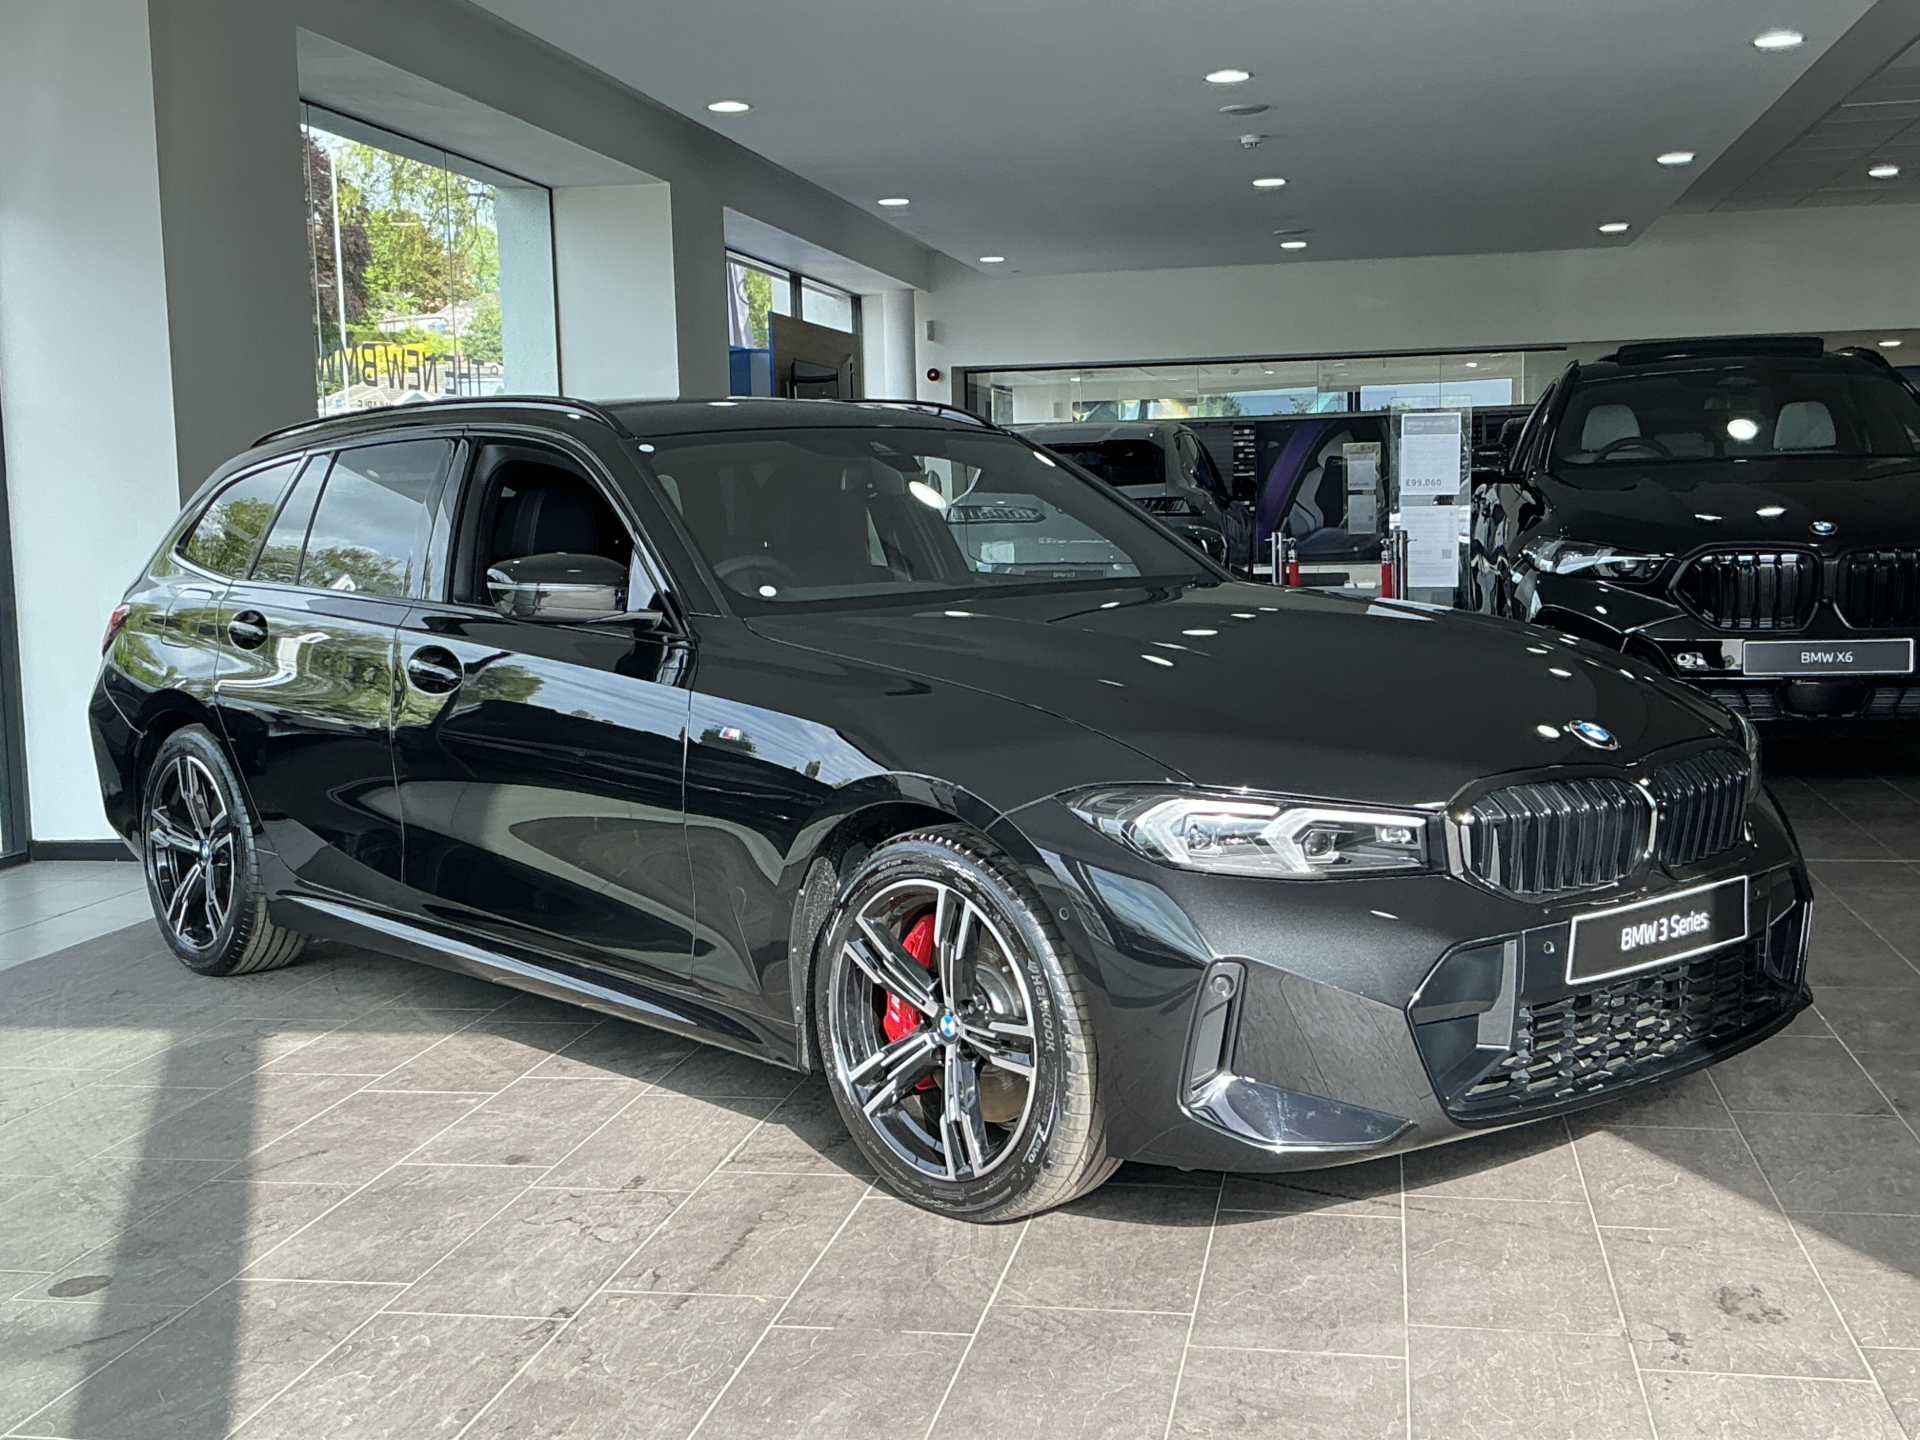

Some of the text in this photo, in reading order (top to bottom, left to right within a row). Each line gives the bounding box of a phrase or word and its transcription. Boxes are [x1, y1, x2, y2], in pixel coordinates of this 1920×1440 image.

[1801, 651, 1854, 664] BMW X6
[1620, 910, 1711, 951] BMW 3 Series
